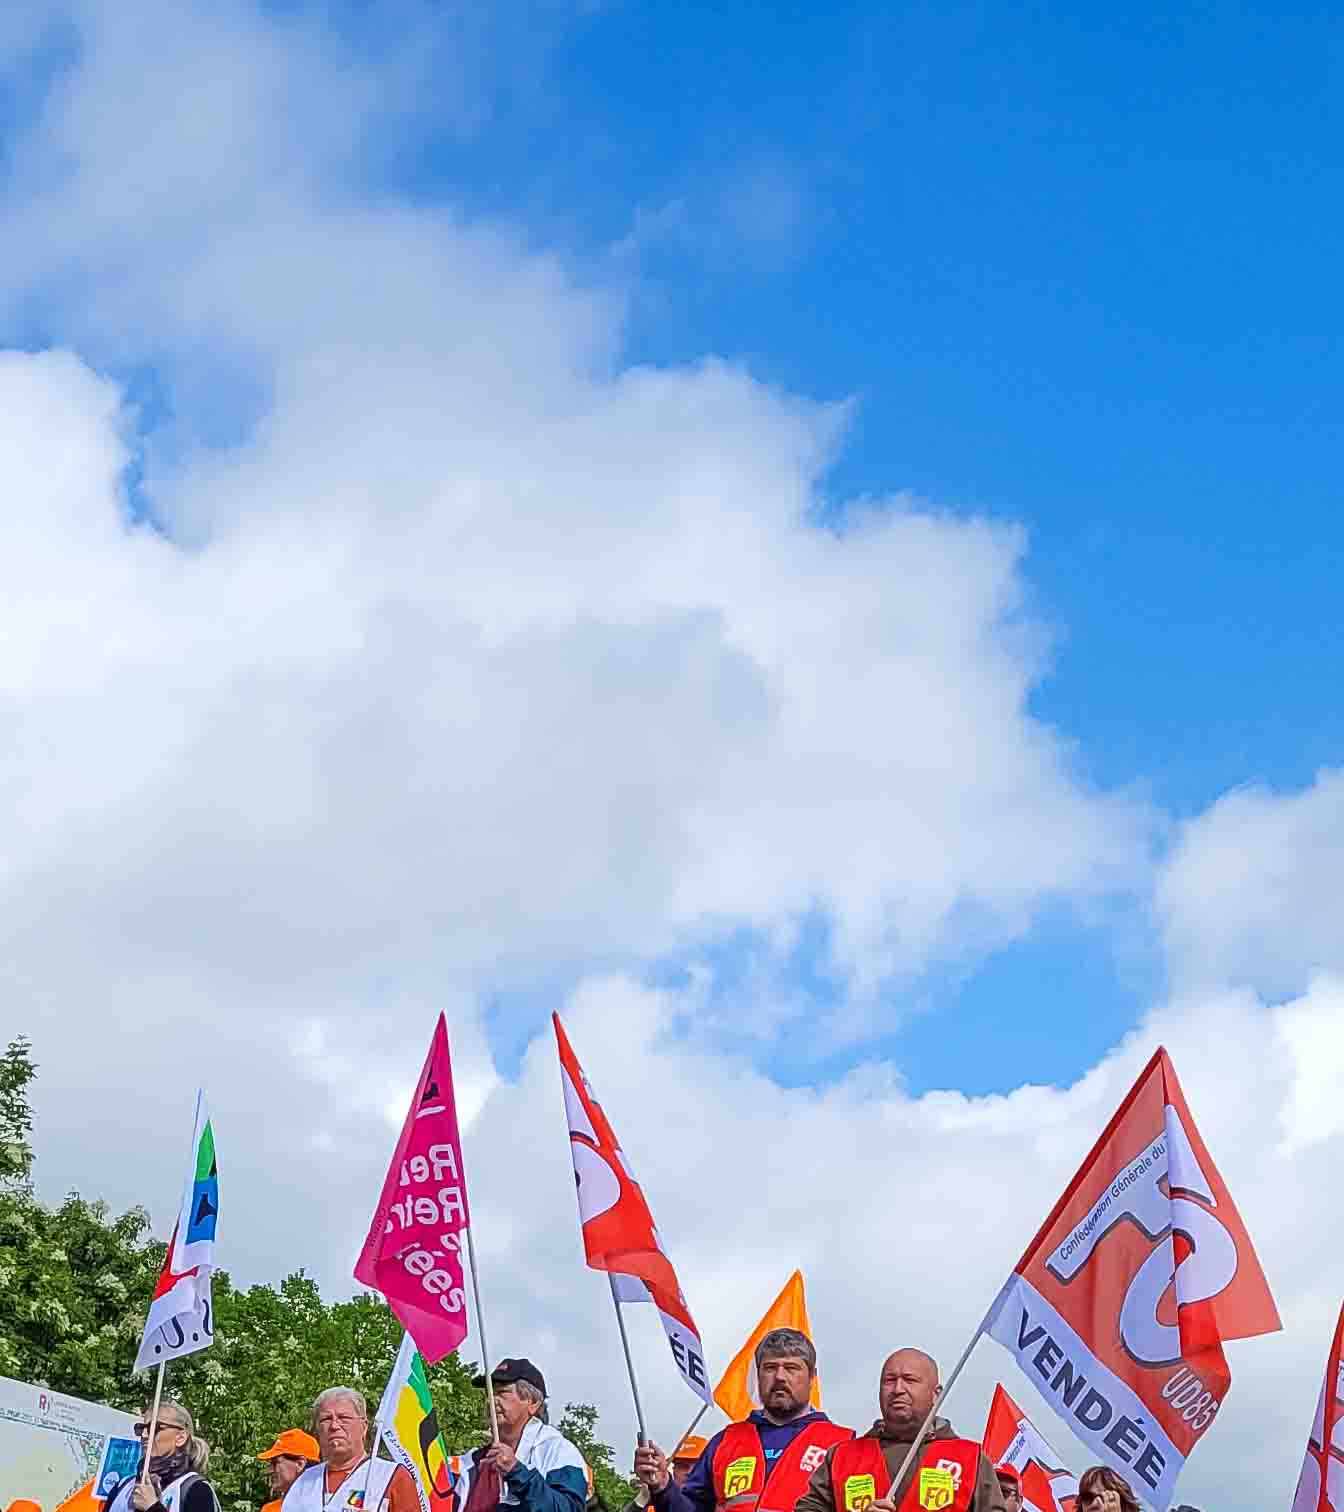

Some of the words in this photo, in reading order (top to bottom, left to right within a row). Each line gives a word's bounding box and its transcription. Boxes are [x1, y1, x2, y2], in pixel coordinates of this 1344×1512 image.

[1110, 1155, 1153, 1200] Générale
[1016, 1306, 1167, 1490] VENDÉE
[1160, 1367, 1222, 1431] UD85
